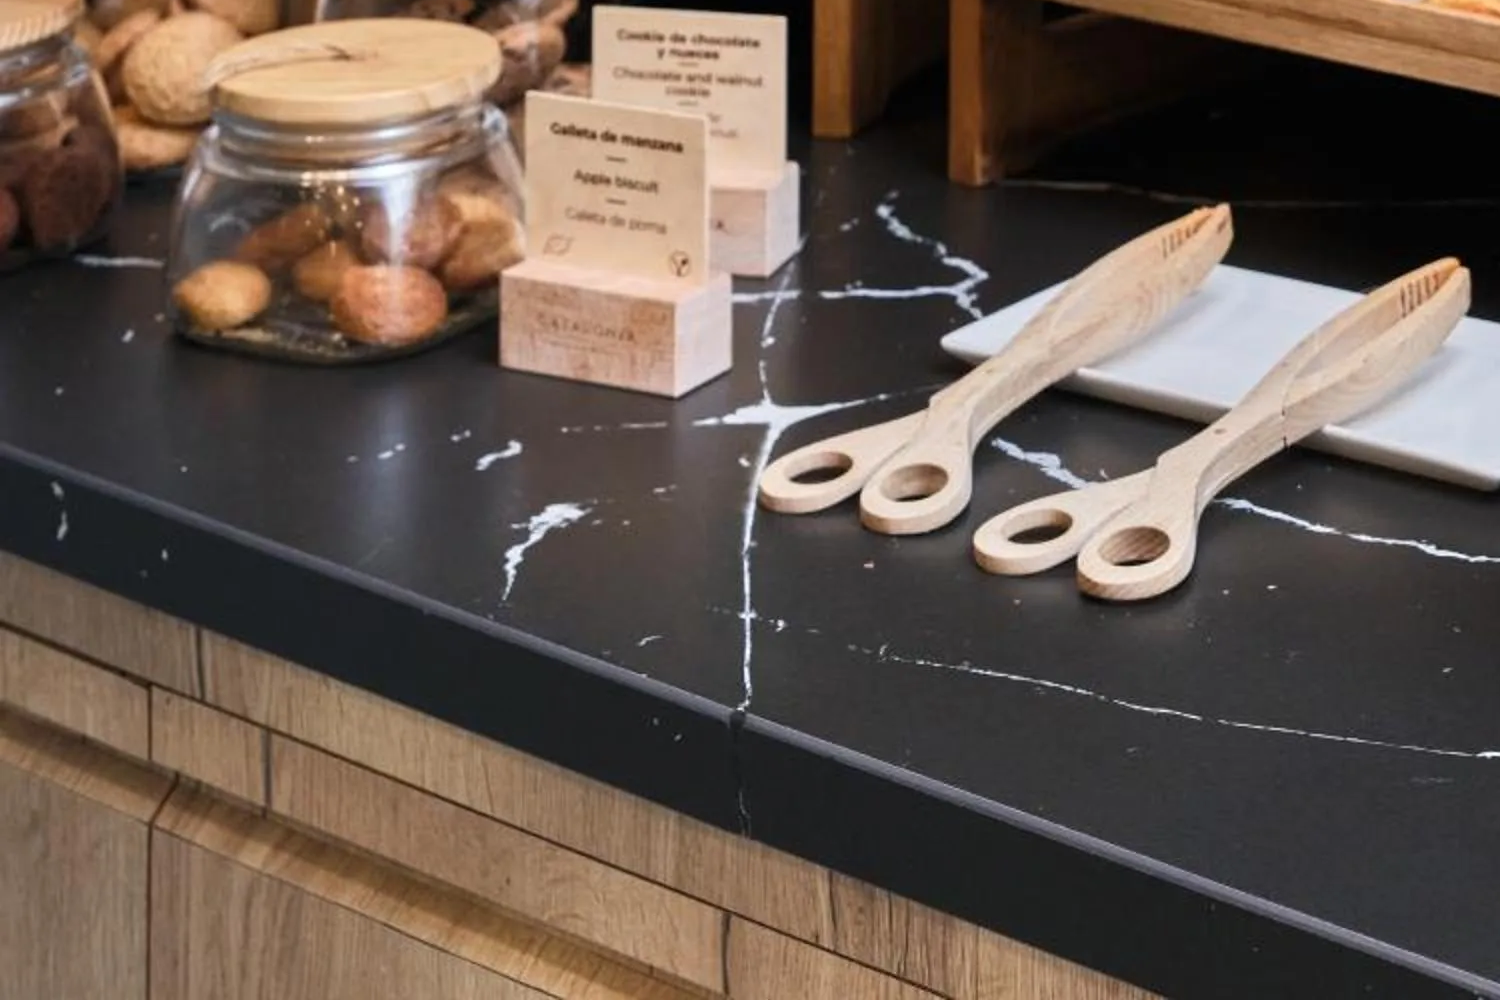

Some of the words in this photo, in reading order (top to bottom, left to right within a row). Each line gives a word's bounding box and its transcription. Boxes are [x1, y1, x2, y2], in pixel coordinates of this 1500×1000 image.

[617, 29, 665, 43] Cookie
[670, 32, 687, 44] de
[690, 34, 760, 49] chocolate
[656, 47, 666, 61] y
[669, 47, 720, 61] nueces
[613, 66, 681, 82] Chocolate
[685, 71, 713, 85] and
[550, 122, 597, 141] Galleta
[601, 129, 618, 143] de
[622, 134, 683, 153] manzana
[574, 169, 611, 188] Apple
[615, 174, 660, 194] biscuit
[607, 213, 626, 227] de
